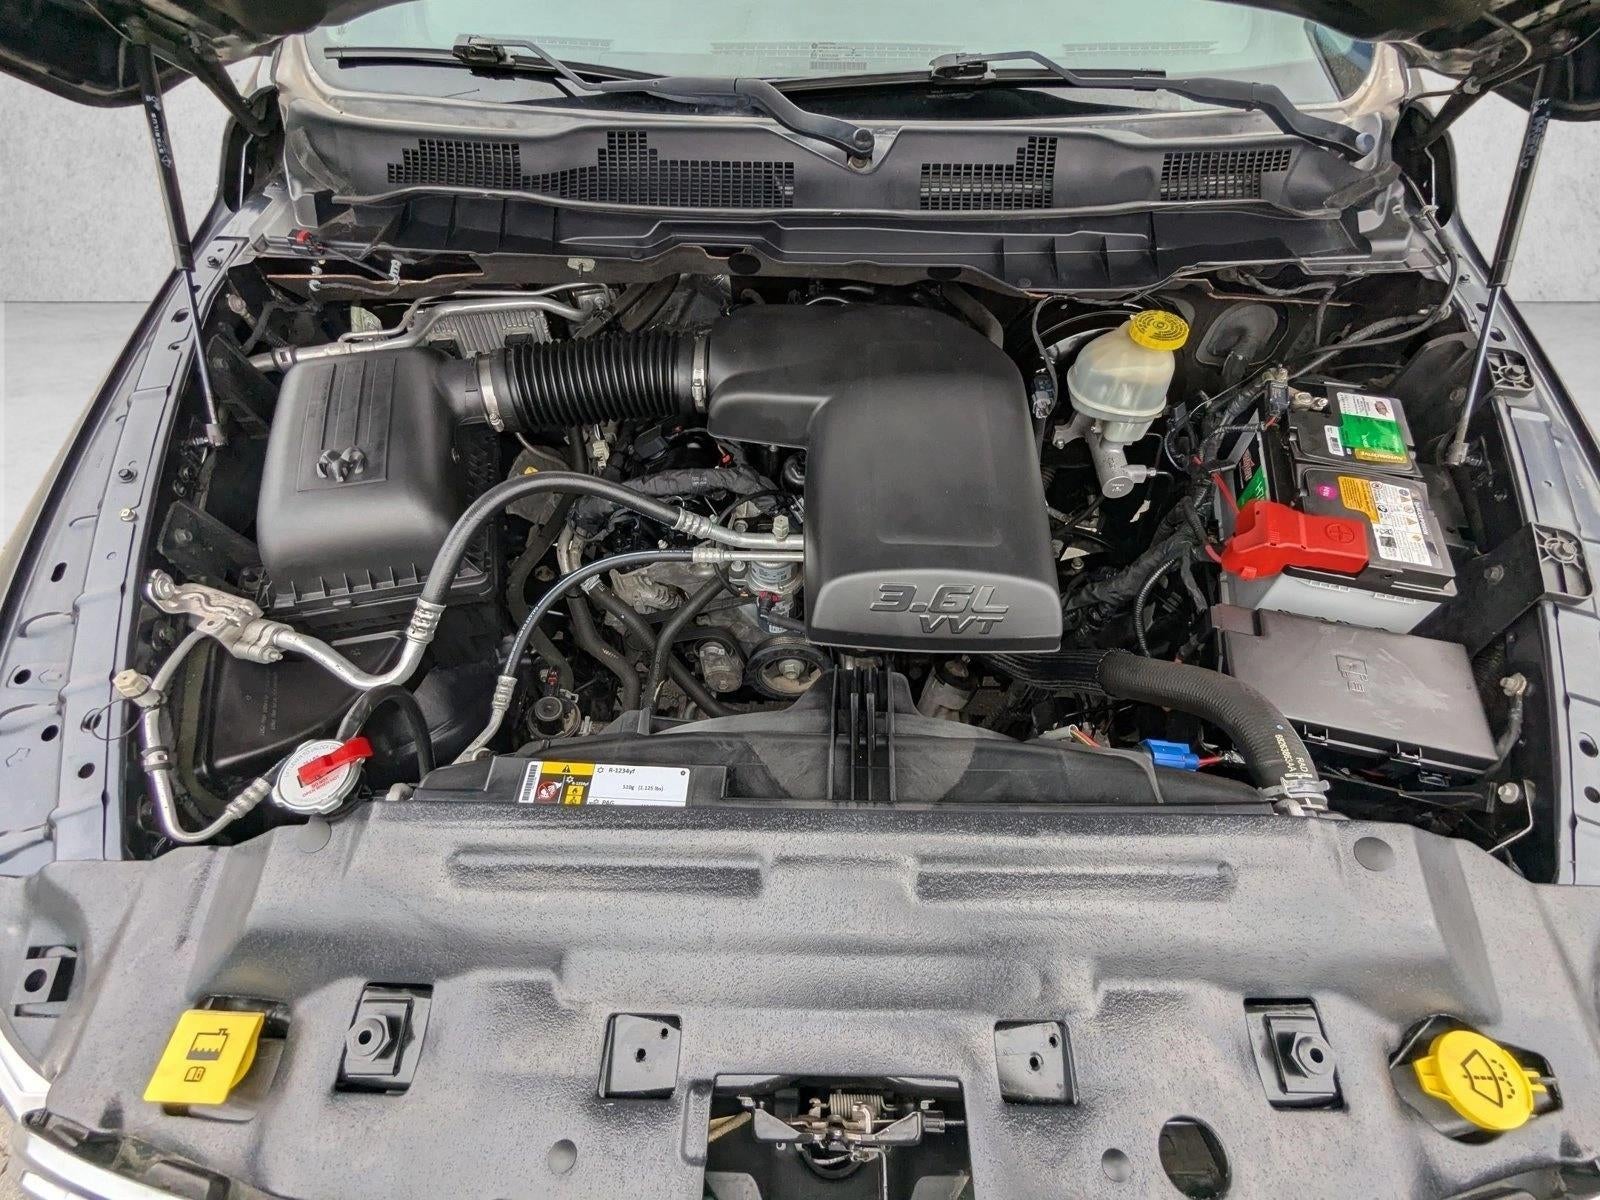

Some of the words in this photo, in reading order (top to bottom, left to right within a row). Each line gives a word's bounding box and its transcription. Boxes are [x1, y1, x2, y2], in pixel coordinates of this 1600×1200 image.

[870, 582, 1009, 614] 3.6L
[919, 614, 1004, 634] VVT
[608, 767, 636, 775] R-1234yf
